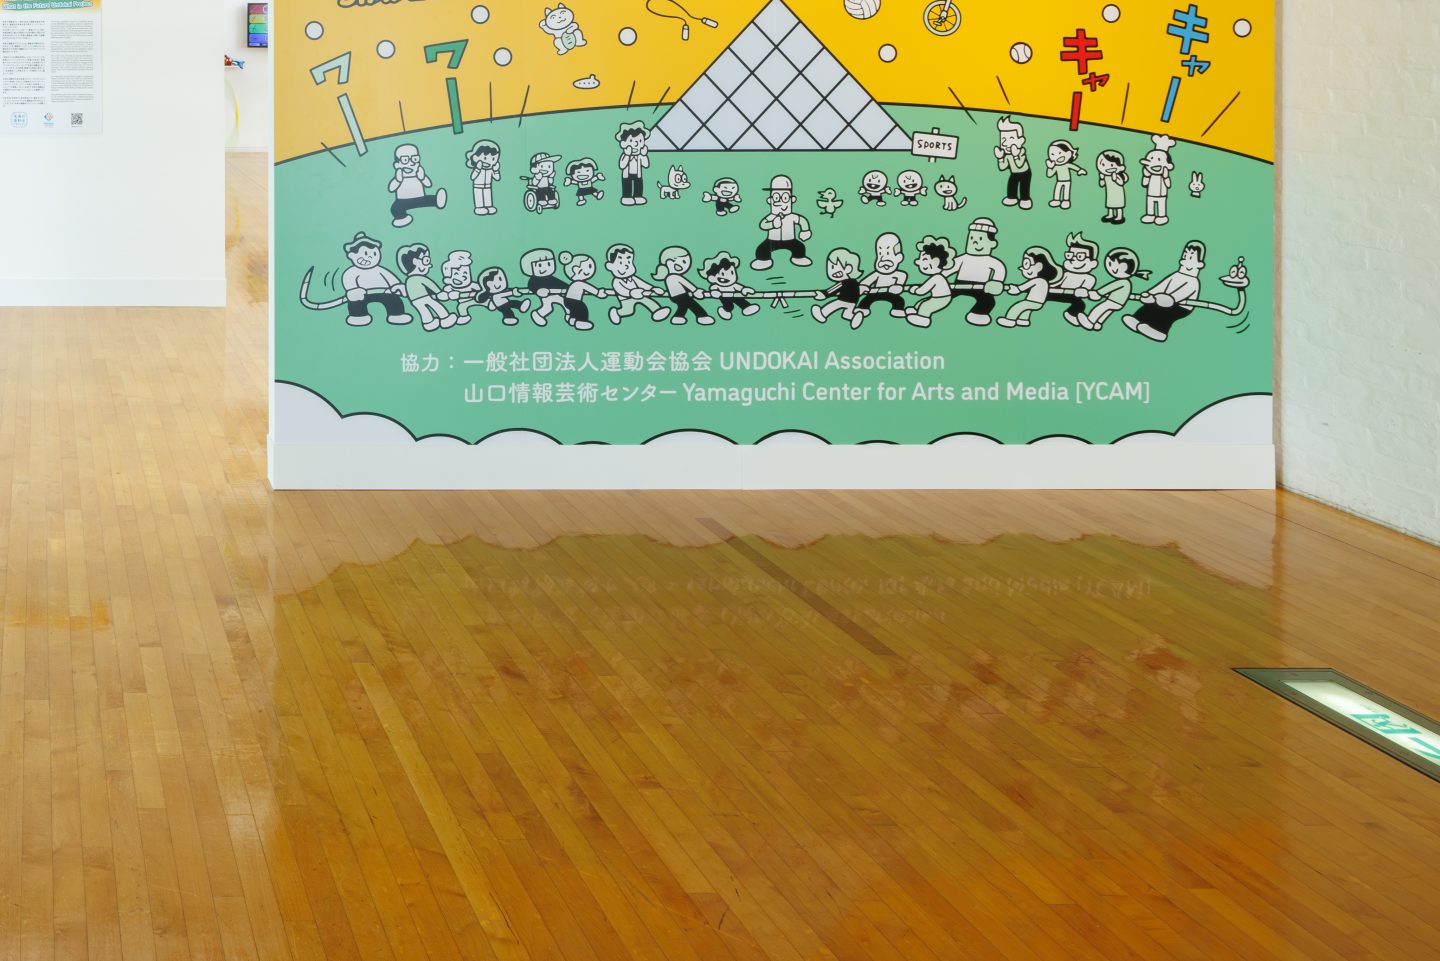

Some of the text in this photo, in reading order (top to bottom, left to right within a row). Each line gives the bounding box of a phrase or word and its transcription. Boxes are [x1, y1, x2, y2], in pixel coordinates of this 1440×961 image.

[917, 139, 953, 151] SPORTS
[720, 351, 818, 370] UNDOKAI
[824, 350, 945, 370] Association
[464, 381, 1150, 407] 山口情報芸術センター Yamaguchi Center for Arts and Media [YCAM]
